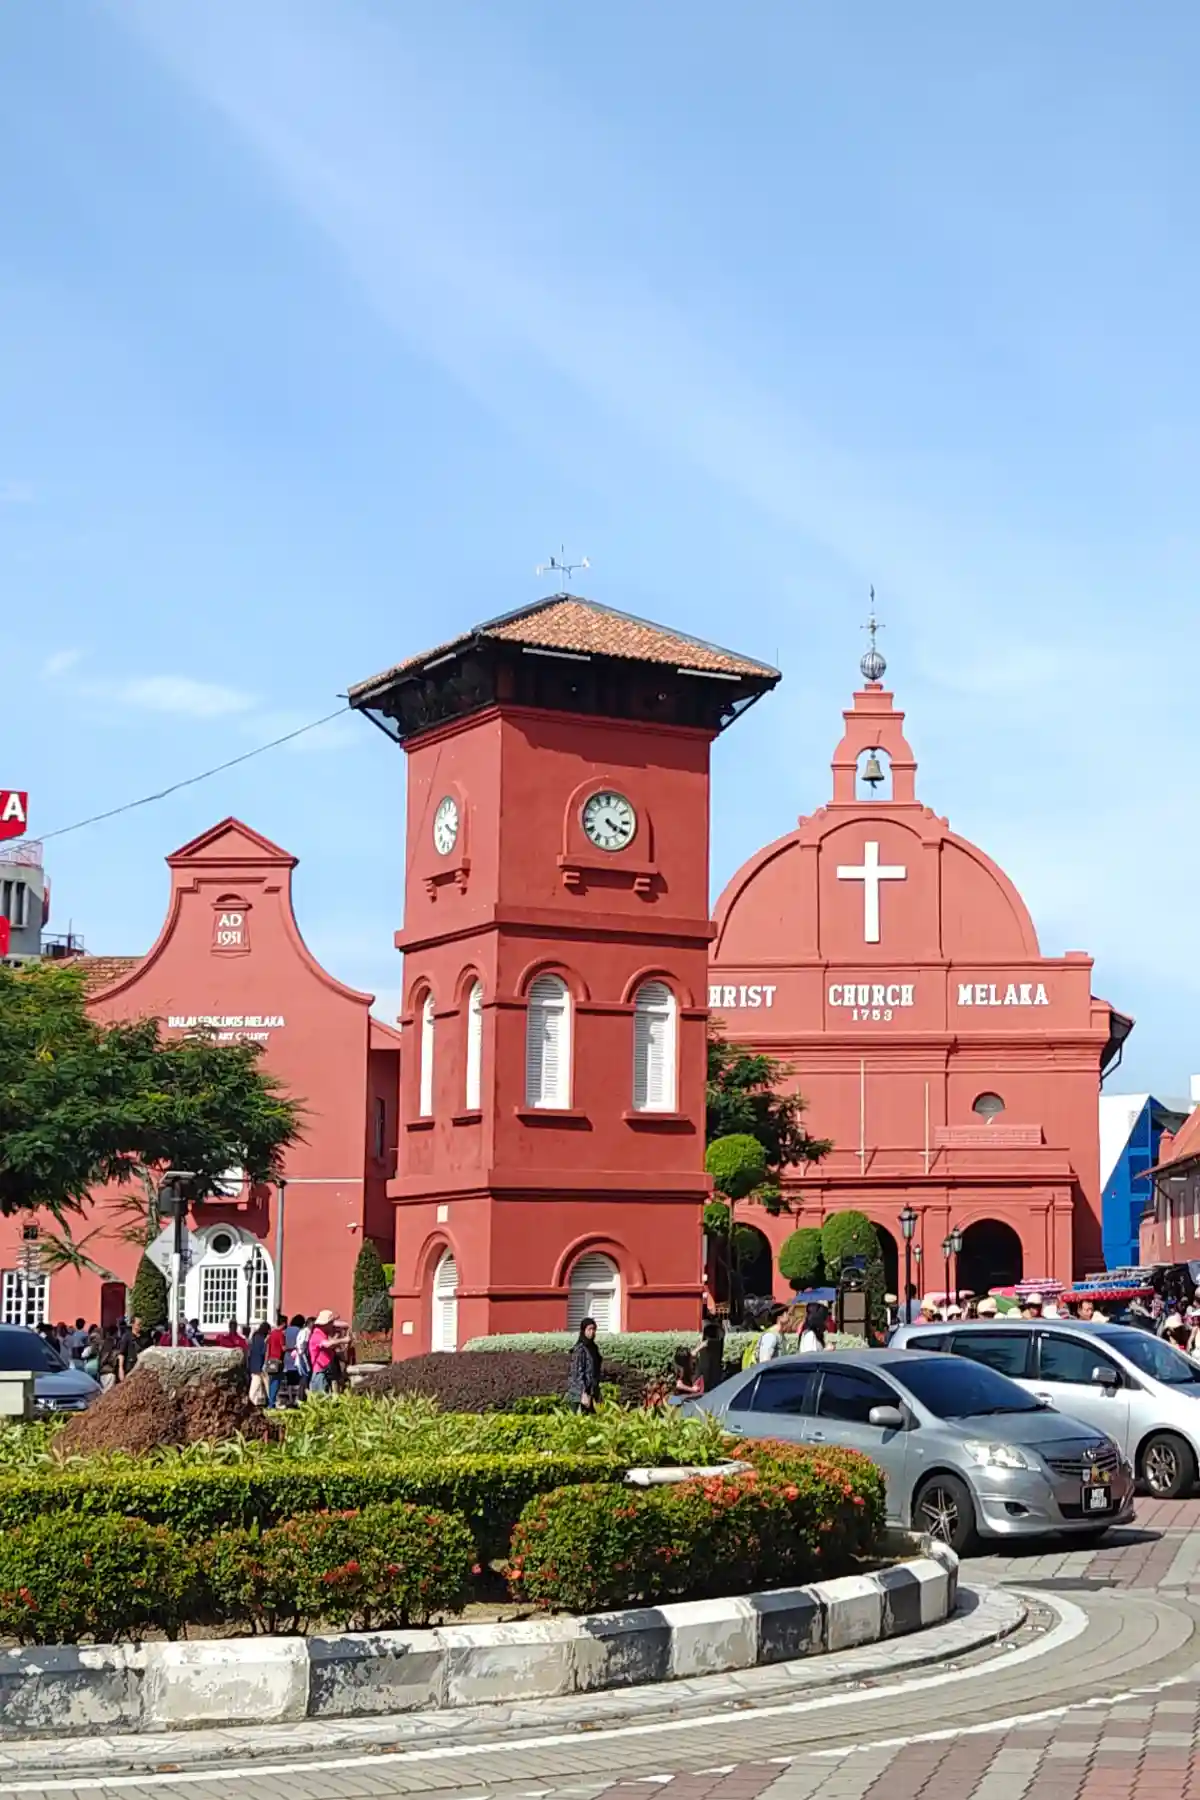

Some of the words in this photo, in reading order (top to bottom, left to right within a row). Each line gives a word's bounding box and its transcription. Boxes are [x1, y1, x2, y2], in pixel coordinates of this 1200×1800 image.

[0, 792, 26, 822] A
[218, 913, 243, 927] AD
[708, 984, 777, 1008] HRIST
[828, 983, 914, 1006] CHURCH
[957, 983, 1050, 1005] MELAKA
[245, 1015, 285, 1028] MELAKA
[852, 1008, 893, 1021] 1753
